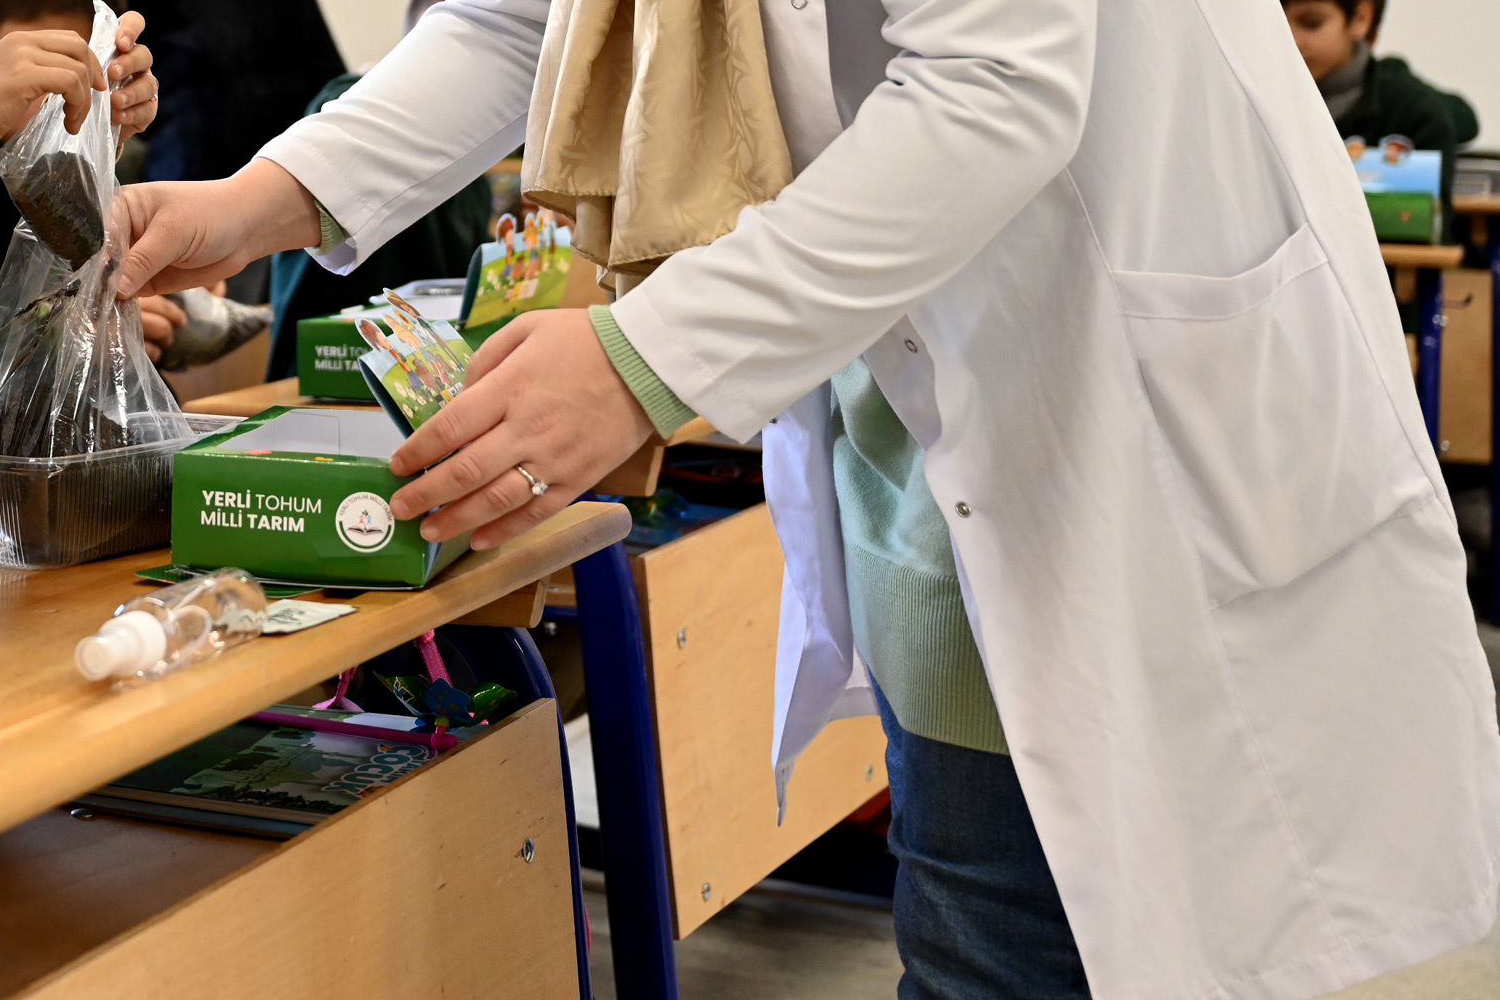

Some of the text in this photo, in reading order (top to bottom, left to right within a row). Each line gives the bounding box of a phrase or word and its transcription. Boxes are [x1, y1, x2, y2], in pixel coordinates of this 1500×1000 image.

[315, 344, 348, 358] YERLİ
[345, 360, 361, 371] TA
[202, 489, 322, 514] YERLİ TOHUM
[201, 508, 305, 533] MİLLİ TARIM
